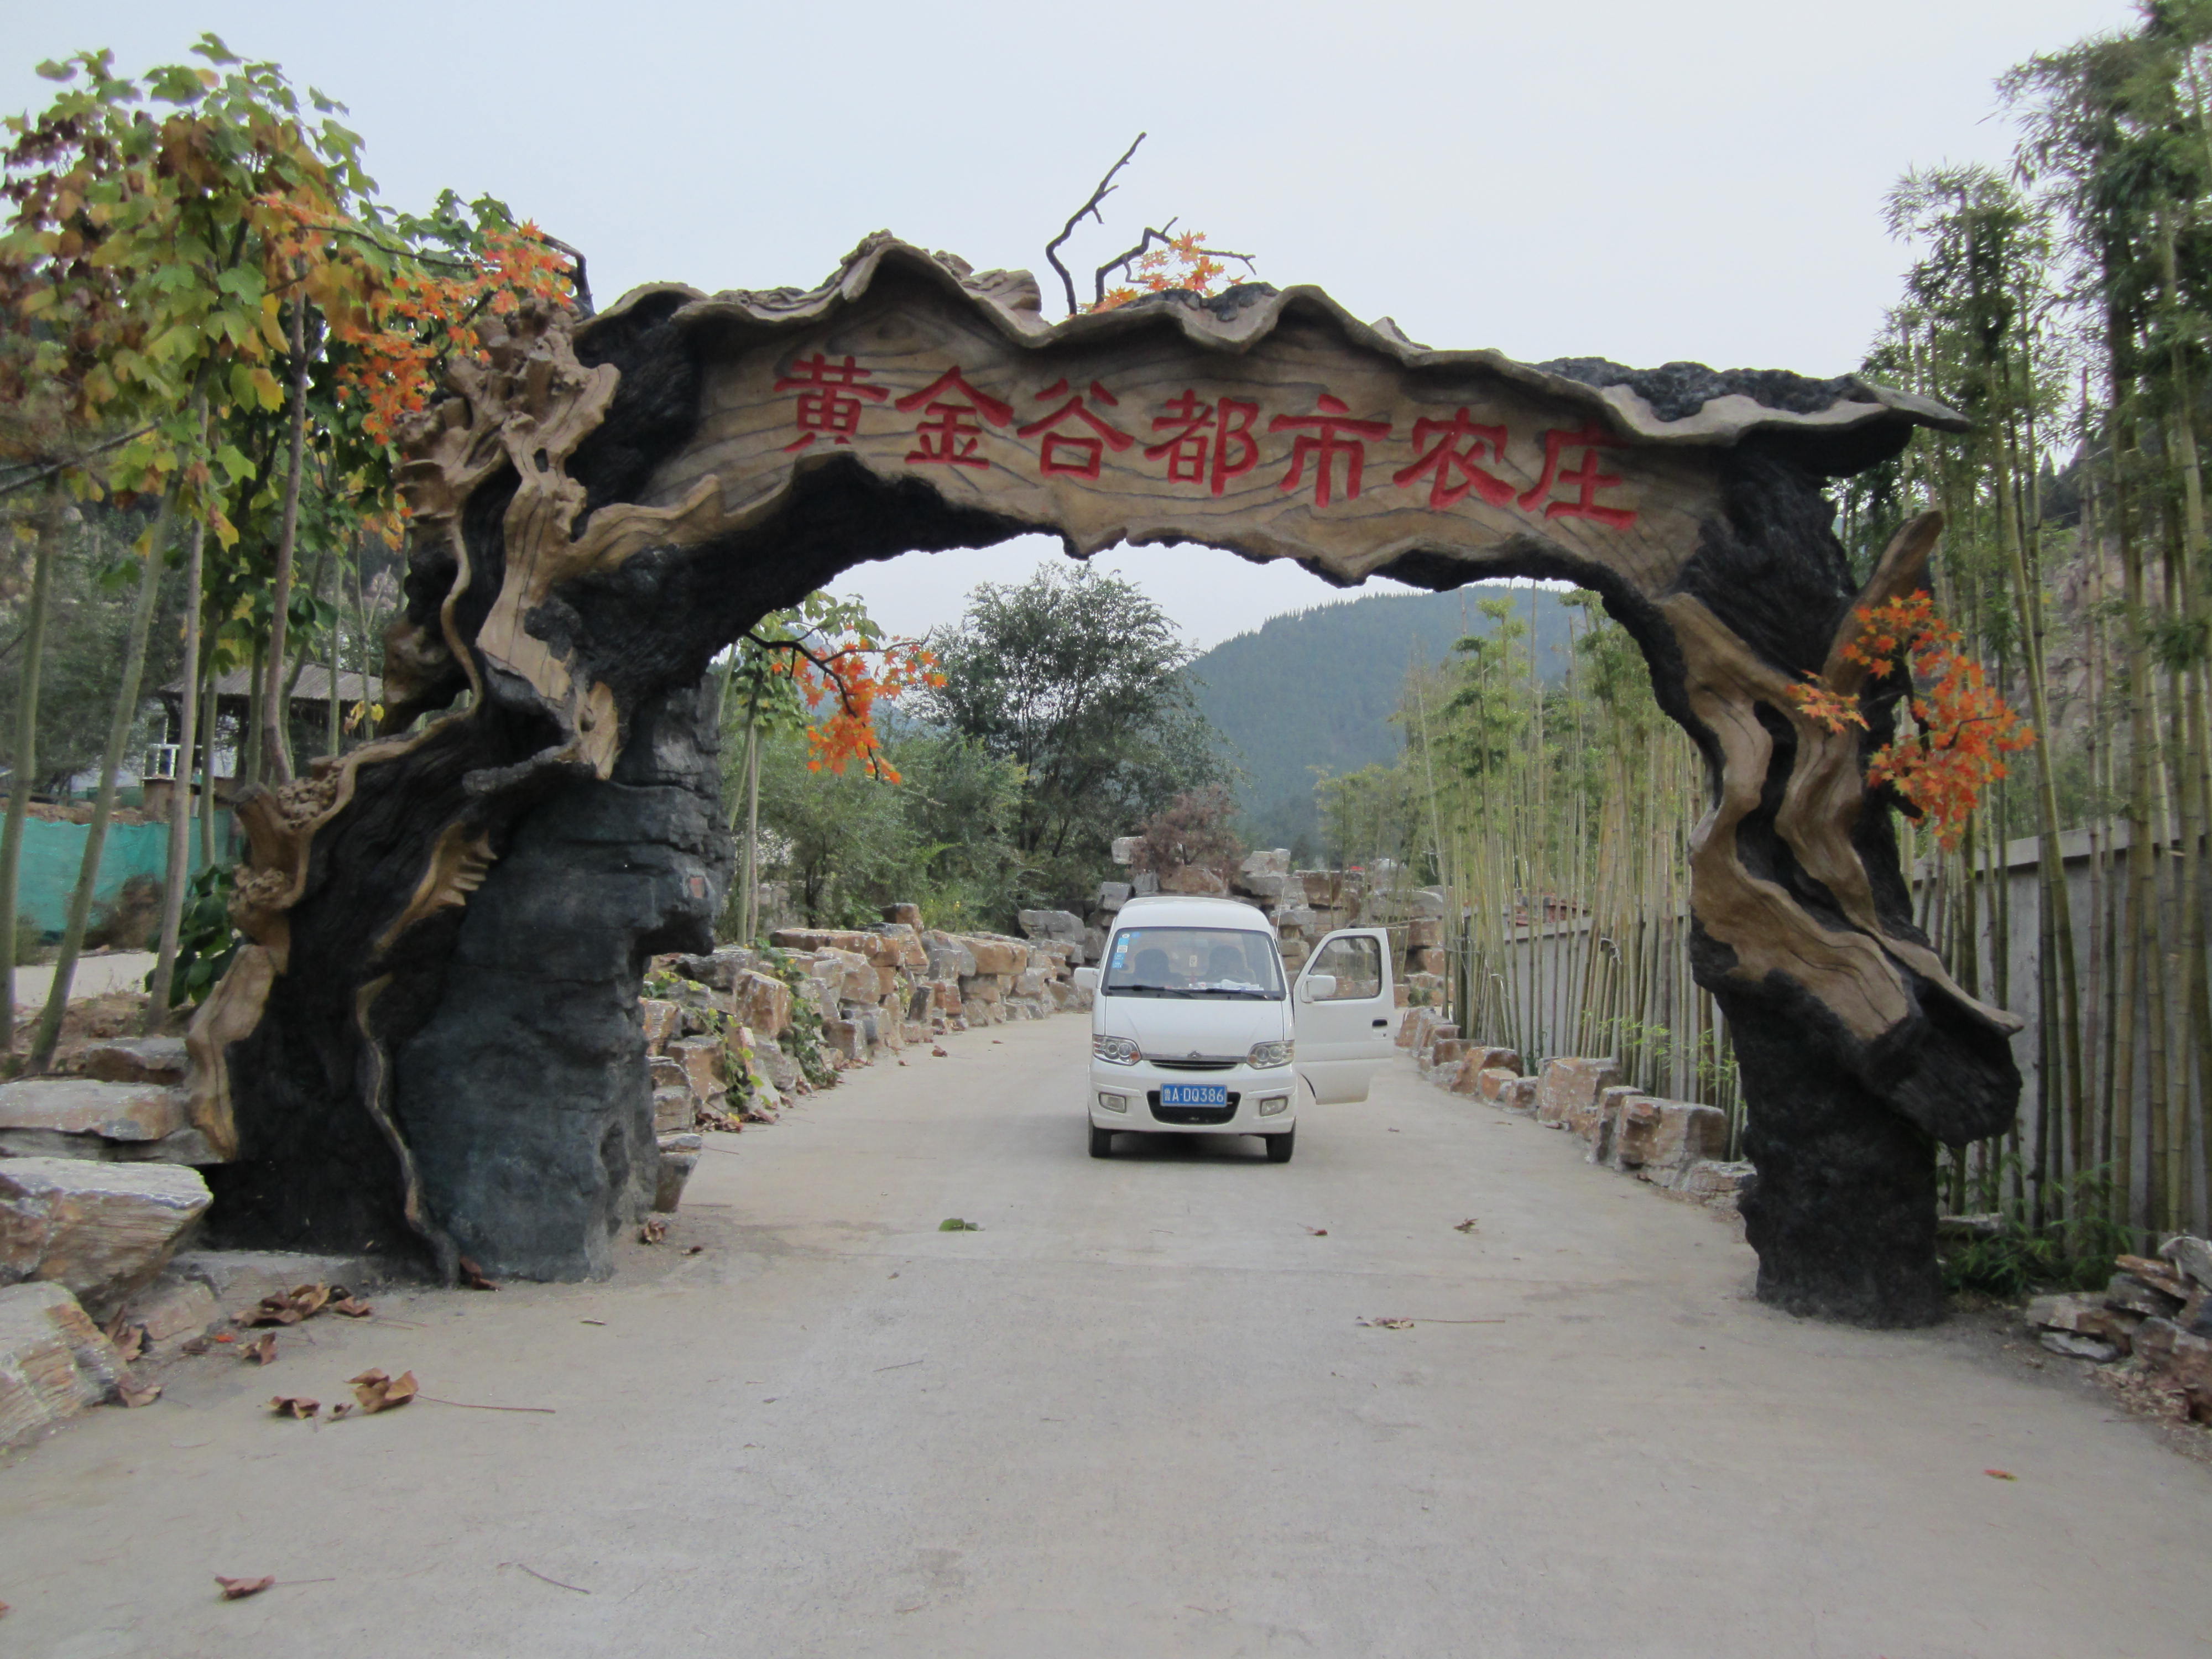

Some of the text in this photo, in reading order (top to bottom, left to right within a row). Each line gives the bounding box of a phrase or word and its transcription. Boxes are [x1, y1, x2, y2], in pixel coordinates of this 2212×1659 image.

[774, 353, 1637, 530] 黄金谷都市农庄
